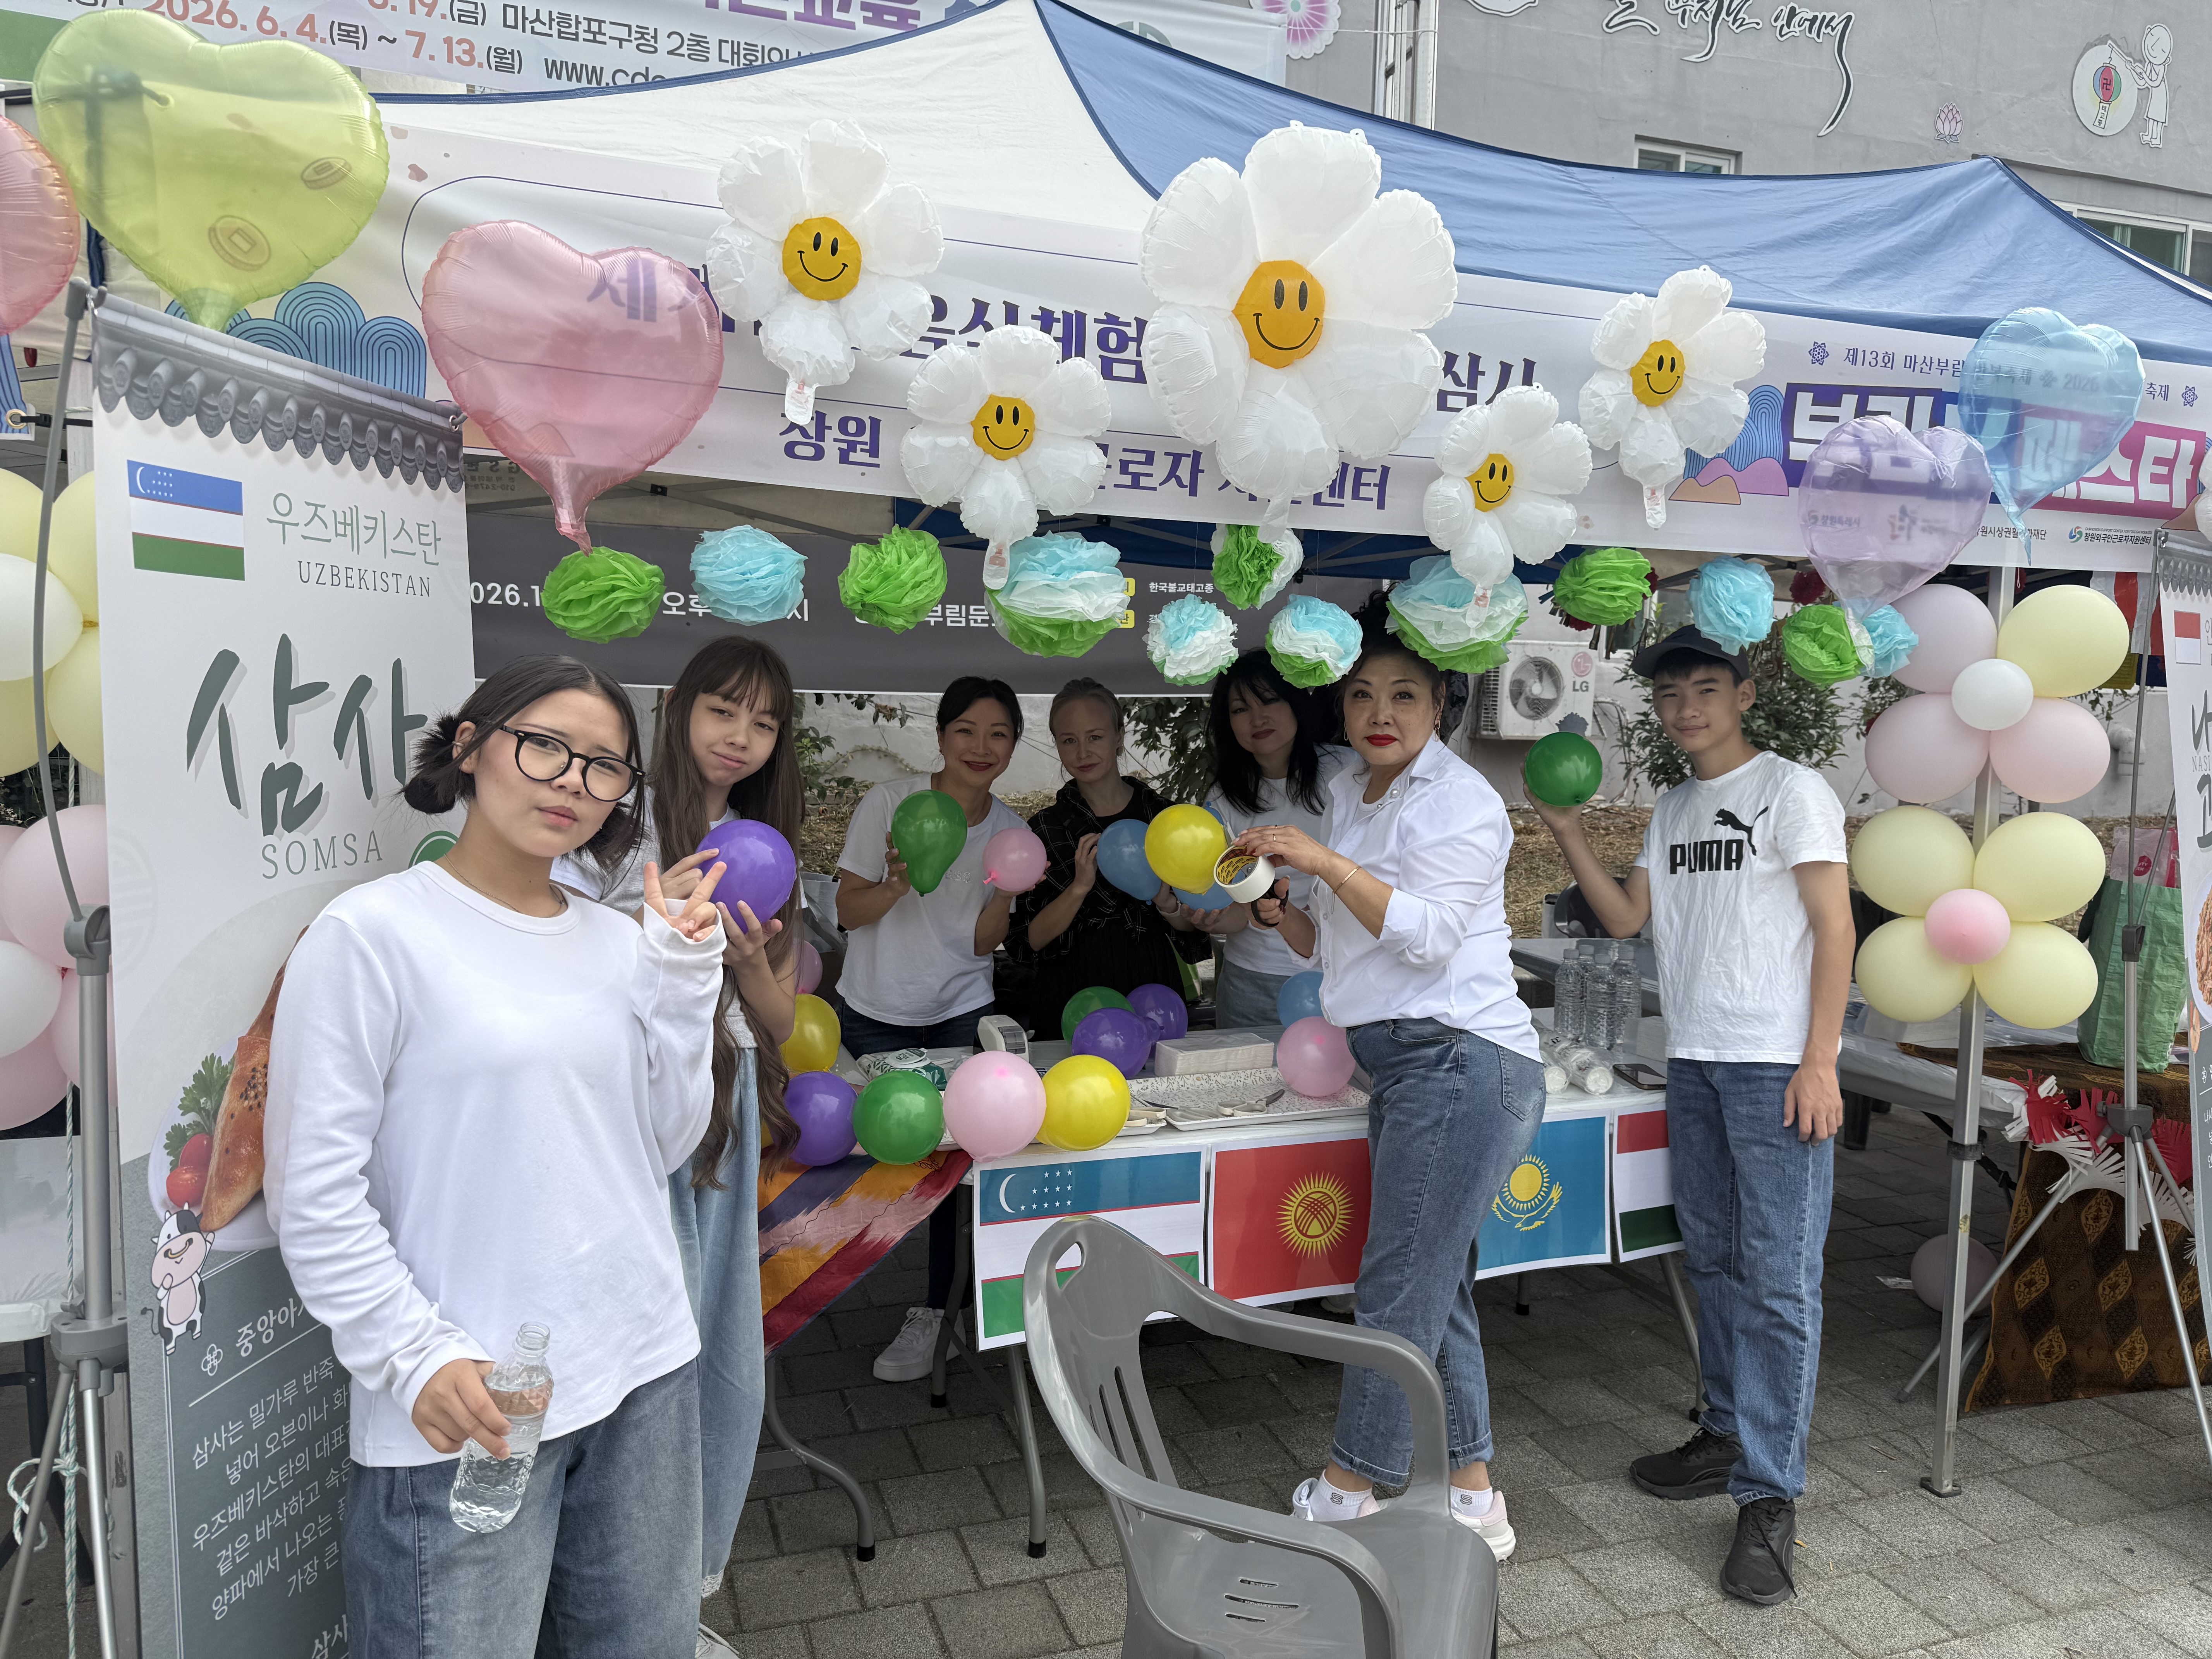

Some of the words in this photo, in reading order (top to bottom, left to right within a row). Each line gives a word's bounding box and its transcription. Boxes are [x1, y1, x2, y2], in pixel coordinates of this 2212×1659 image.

[295, 13, 368, 50] 4.(목)
[442, 36, 523, 75] 13.(월)
[503, 3, 659, 54] 마산합포구청
[666, 31, 711, 63] 2층
[1843, 347, 1895, 370] 제13회
[267, 493, 441, 566] 우즈베키스탄
[2084, 532, 2152, 545] 창원외국인근로자지원센터
[298, 560, 431, 598] UZBEKISTAN
[1149, 582, 1214, 593] 한국불교태고종
[1572, 681, 1589, 692] LG
[187, 634, 428, 837] 삼사
[2192, 755, 2210, 773] NASI
[262, 830, 383, 879] SOMSA
[1670, 839, 1744, 875] PUMA
[236, 1298, 305, 1357] 중앙아
[193, 1420, 244, 1470] 삼사는
[249, 1379, 299, 1430] 밀가루
[303, 1356, 334, 1394] 반죽
[226, 1443, 258, 1486] 넣어
[265, 1397, 328, 1458] 오븐이나
[192, 1447, 309, 1551] 우즈베키스탄의
[216, 1534, 251, 1577] 겉은
[256, 1481, 321, 1542] 바삭하고
[212, 1547, 279, 1620] 양파에서
[285, 1513, 332, 1559] 나오는
[288, 1556, 319, 1597] 가장
[324, 1541, 340, 1570] 큰
